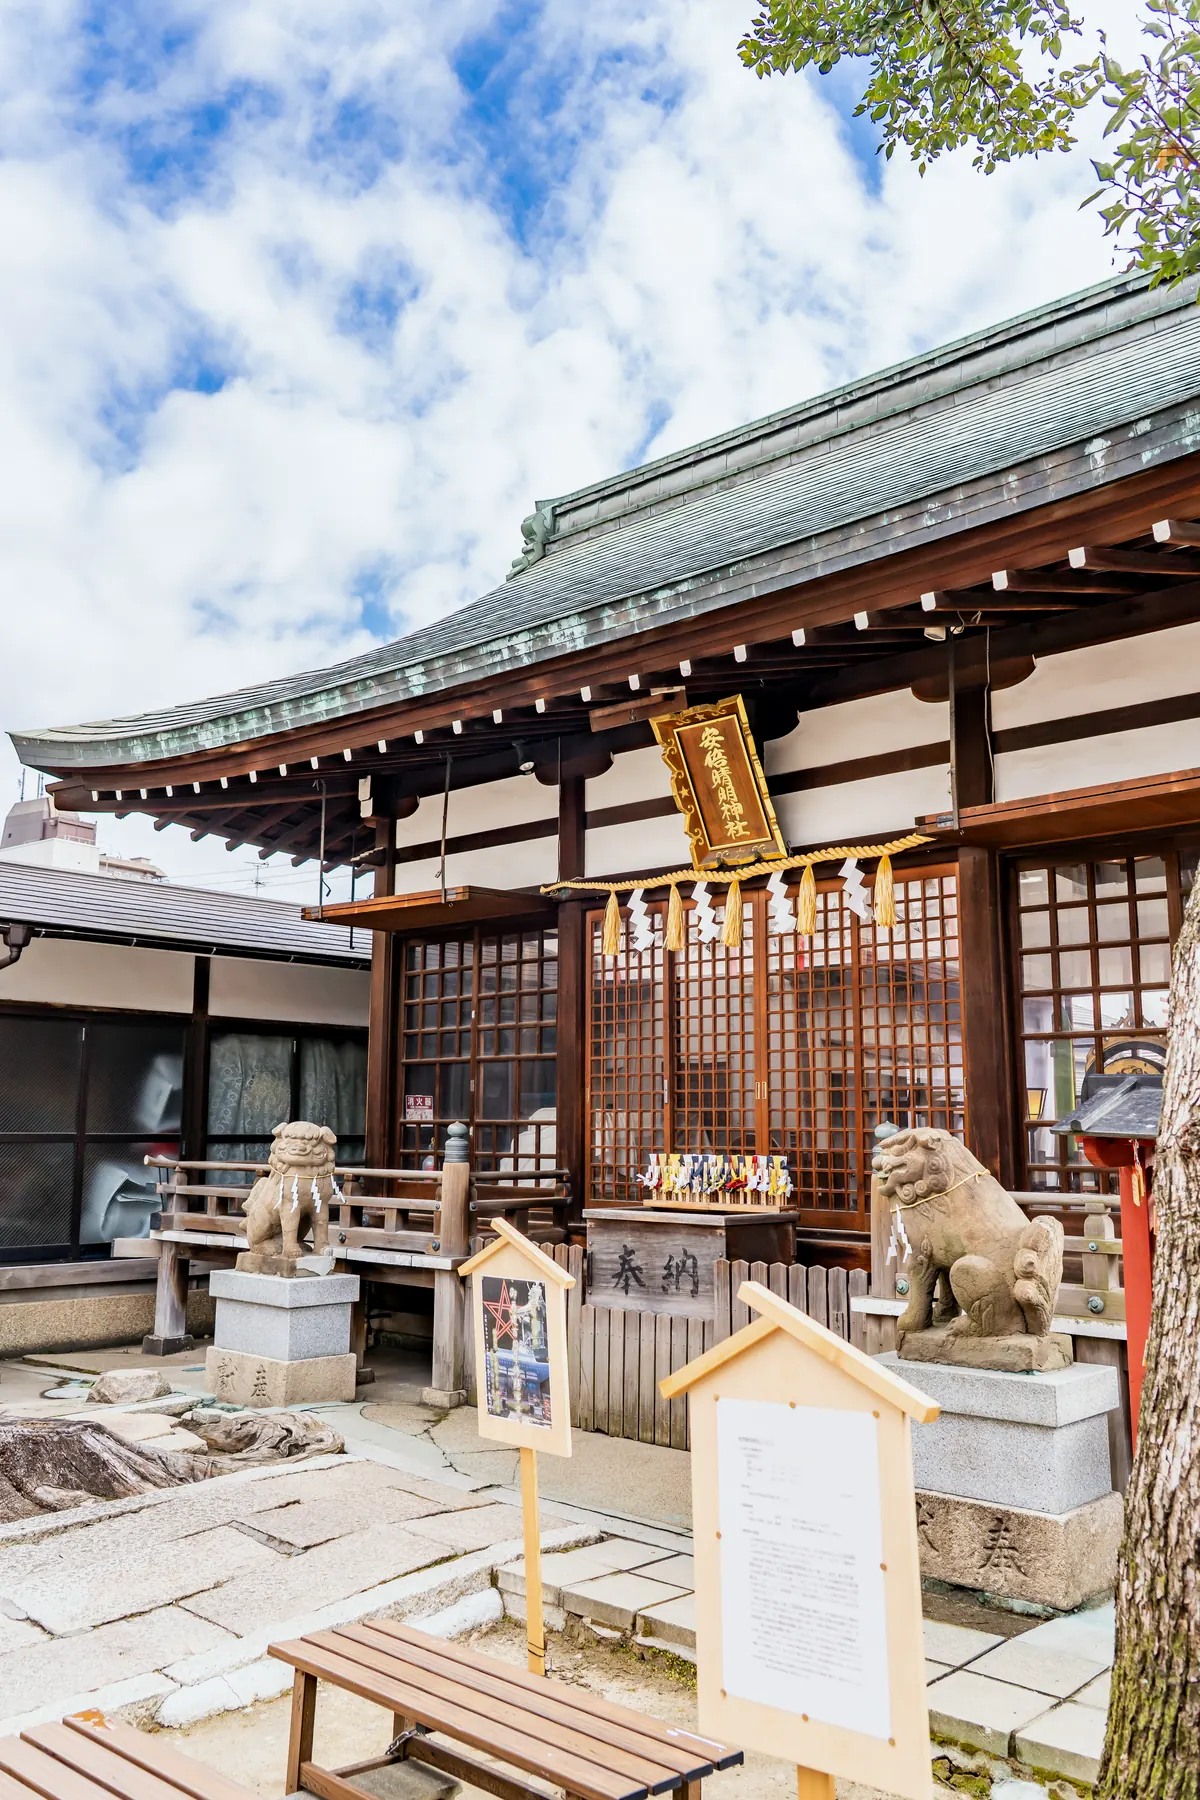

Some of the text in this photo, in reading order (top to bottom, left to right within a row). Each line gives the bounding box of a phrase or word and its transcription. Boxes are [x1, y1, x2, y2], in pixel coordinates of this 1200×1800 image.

[699, 727, 750, 840] 安倍晴明神社
[407, 1097, 432, 1106] 消火器
[611, 1244, 699, 1298] 奉納
